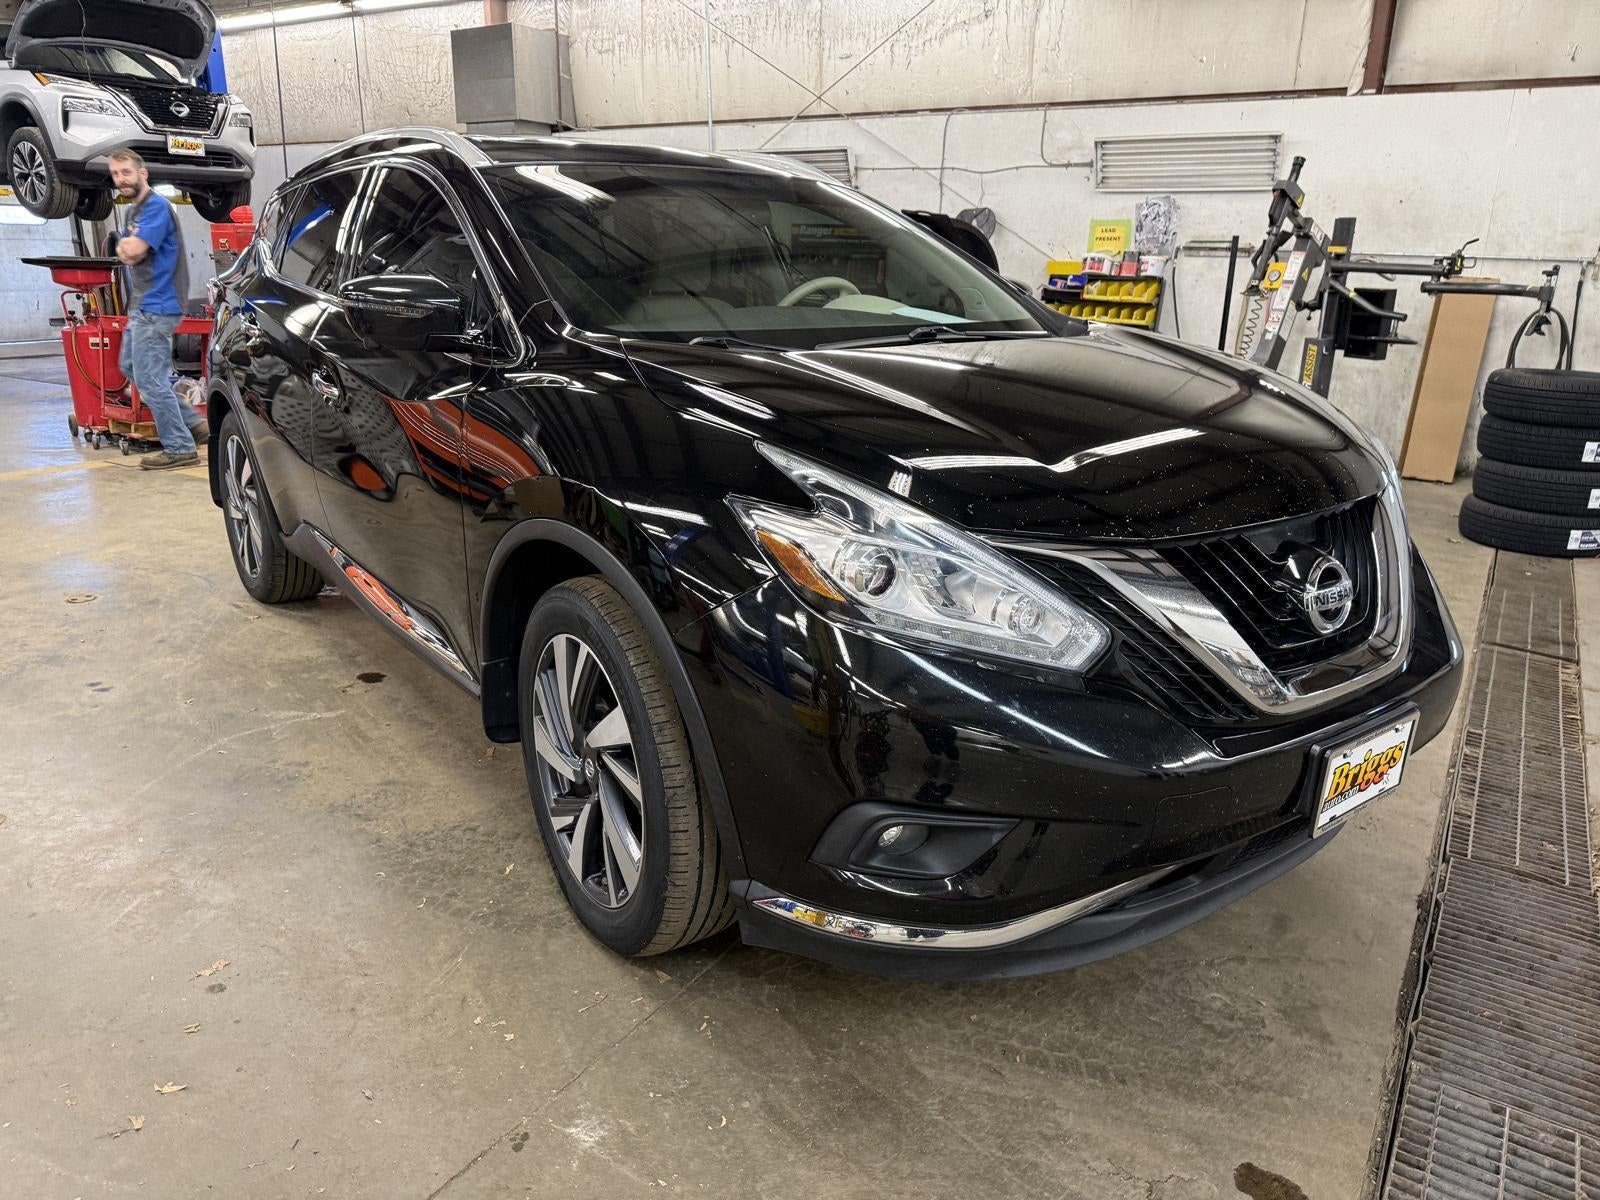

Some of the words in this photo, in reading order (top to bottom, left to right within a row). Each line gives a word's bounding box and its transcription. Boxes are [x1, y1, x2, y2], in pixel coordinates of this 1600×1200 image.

[171, 138, 203, 151] Briggs
[1304, 347, 1316, 382] ASSIST
[1314, 586, 1353, 607] NISSAN
[1325, 741, 1405, 802] Briggs
